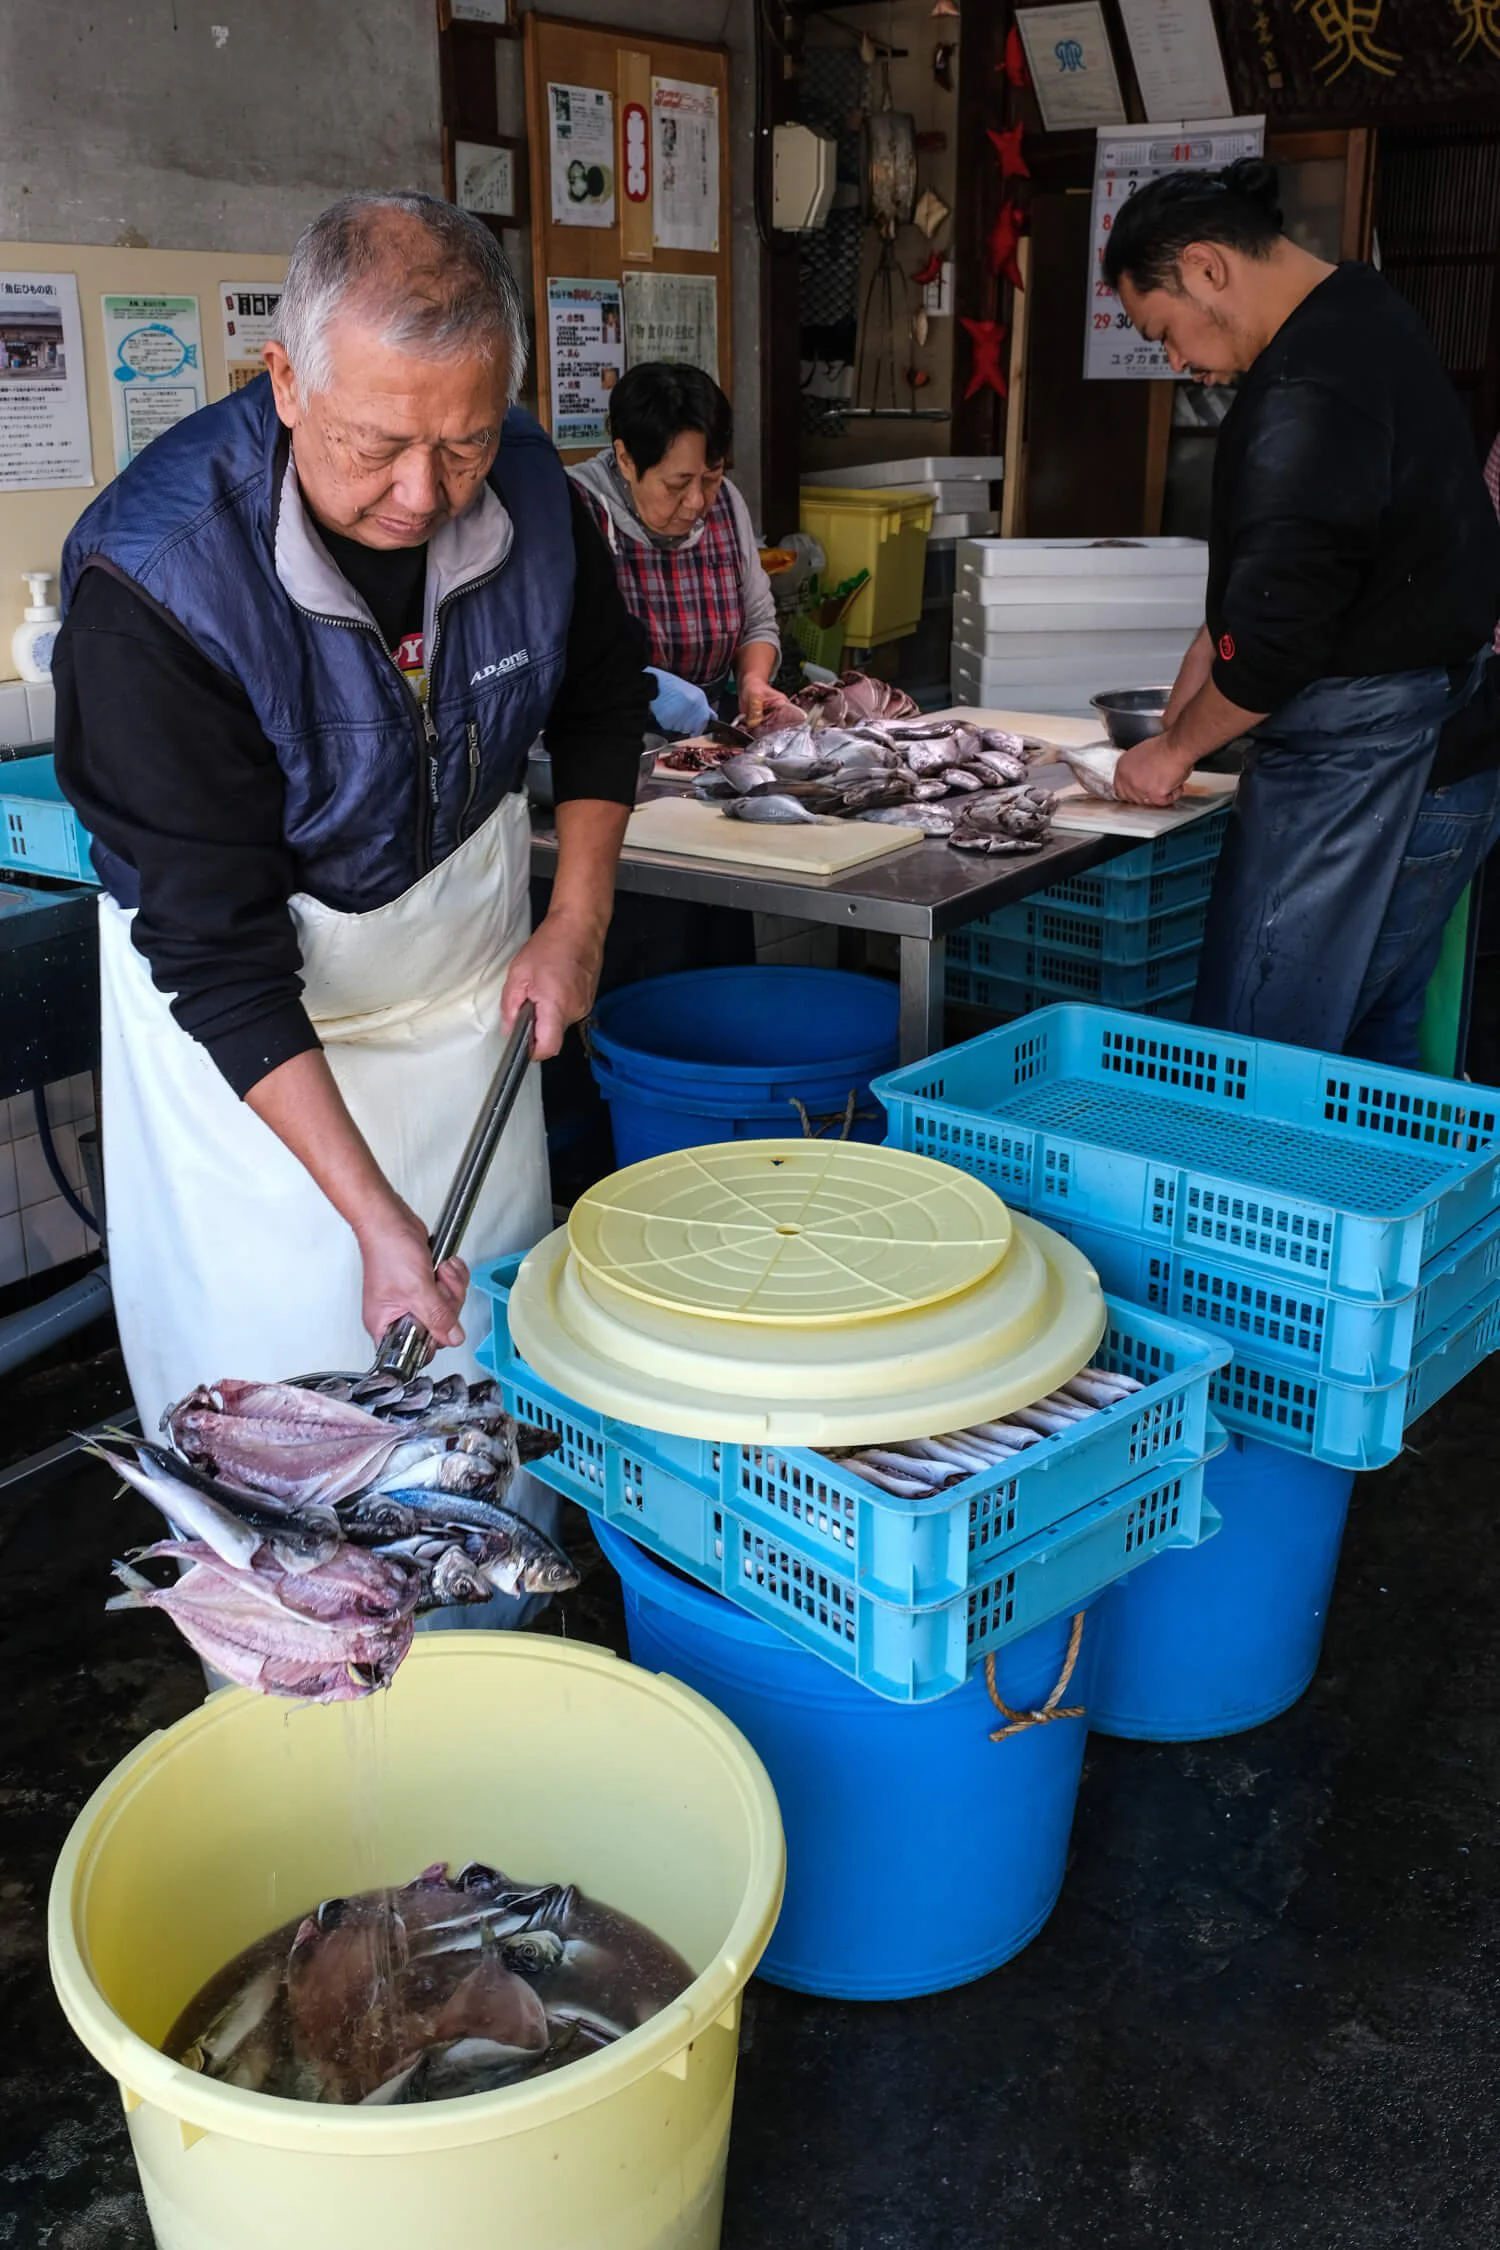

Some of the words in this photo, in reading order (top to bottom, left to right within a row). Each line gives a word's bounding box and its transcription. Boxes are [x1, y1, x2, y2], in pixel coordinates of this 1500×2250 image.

[1174, 143, 1190, 161] 11
[1107, 181, 1113, 197] 1
[1128, 180, 1137, 197] 2
[1103, 214, 1112, 231] 8
[1095, 281, 1112, 297] 22
[1093, 313, 1111, 329] 29
[1115, 313, 1132, 329] 30
